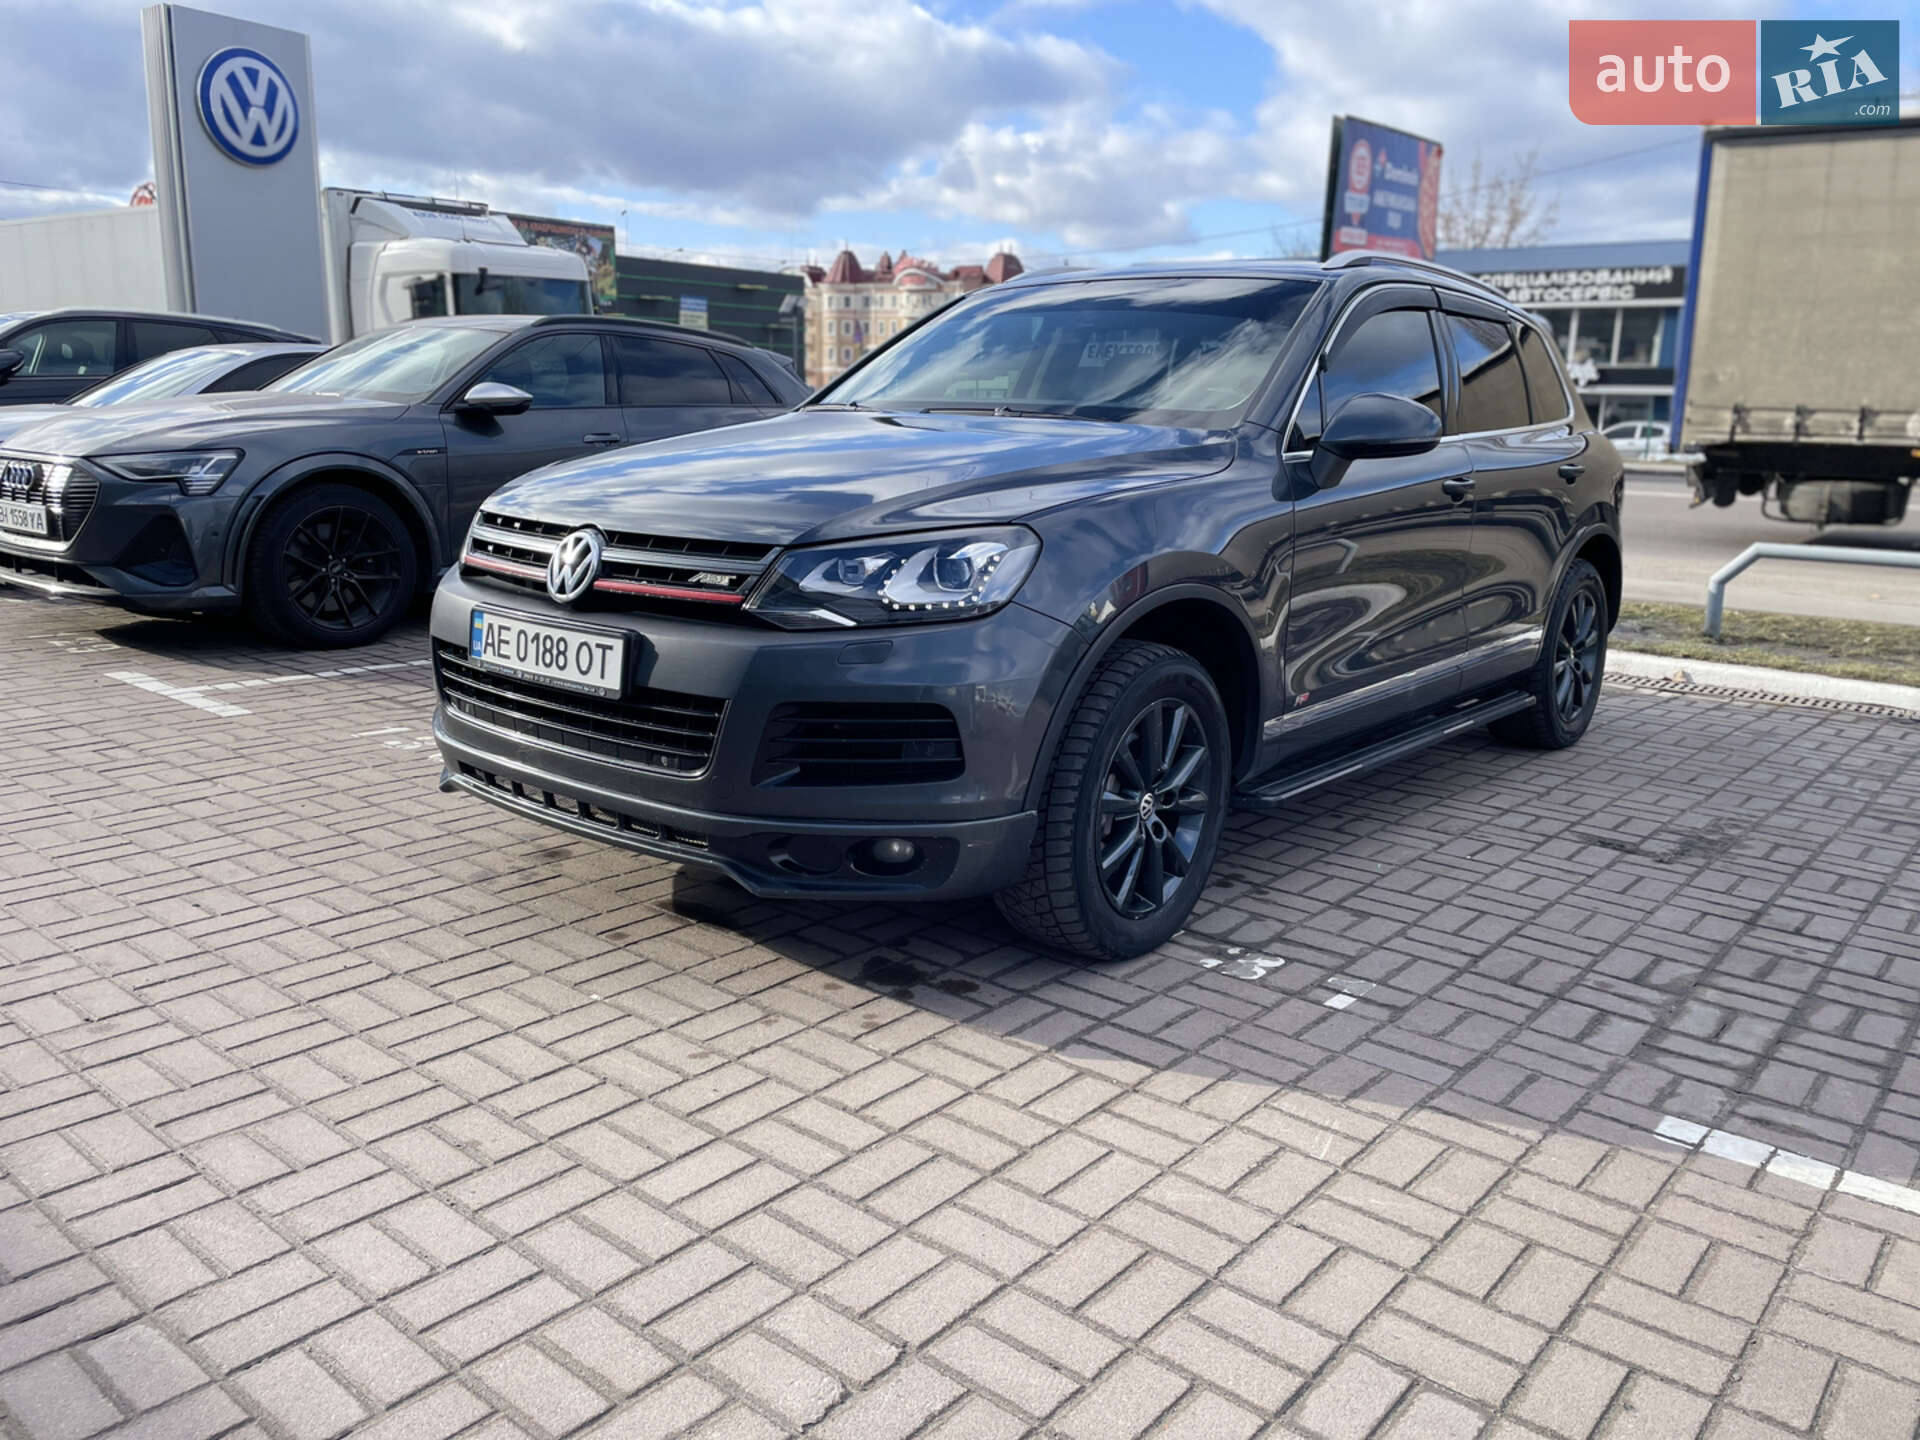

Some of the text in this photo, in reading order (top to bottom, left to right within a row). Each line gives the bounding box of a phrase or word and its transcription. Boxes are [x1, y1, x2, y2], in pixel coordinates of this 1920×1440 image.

[1506, 285, 1636, 303] АВТОСЕРВІС
[484, 622, 511, 660] AE
[516, 629, 568, 671] 0188
[576, 641, 614, 680] OT
